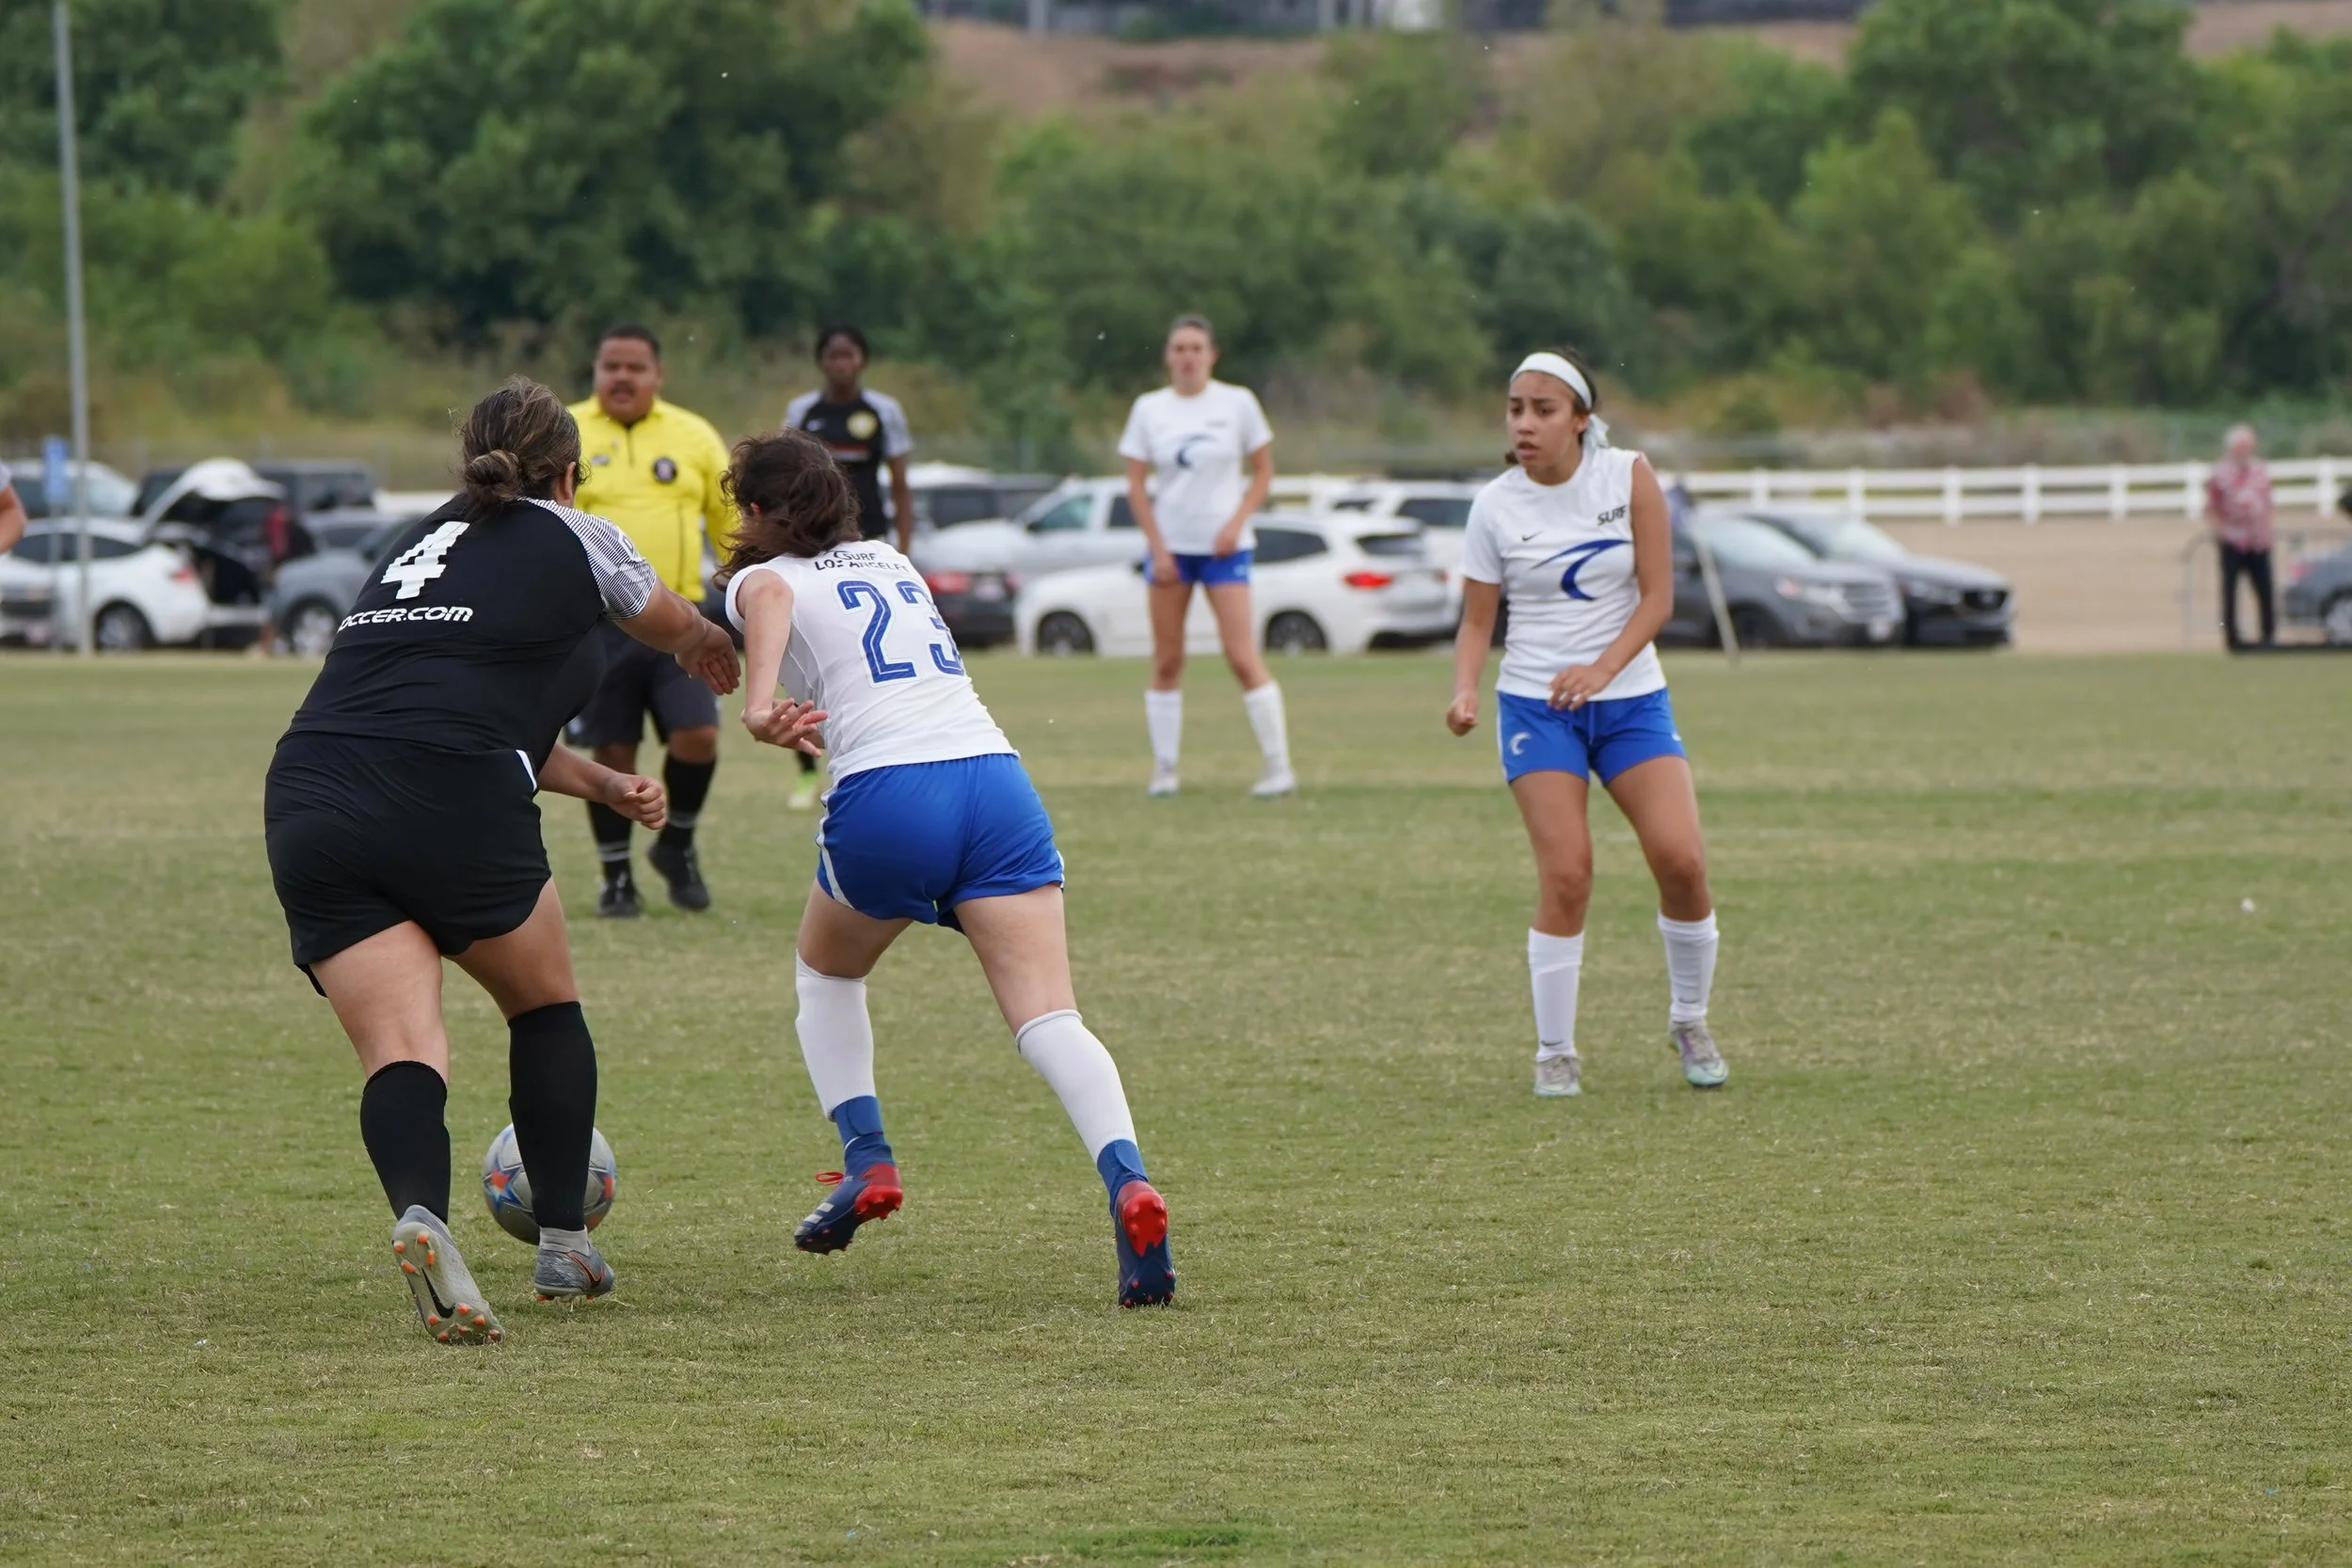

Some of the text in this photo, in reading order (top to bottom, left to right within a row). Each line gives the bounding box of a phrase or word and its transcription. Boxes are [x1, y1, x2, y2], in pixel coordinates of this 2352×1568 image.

[1597, 504, 1627, 527] SURF
[380, 521, 470, 599] 4
[842, 552, 876, 561] SURF
[836, 580, 964, 683] 23
